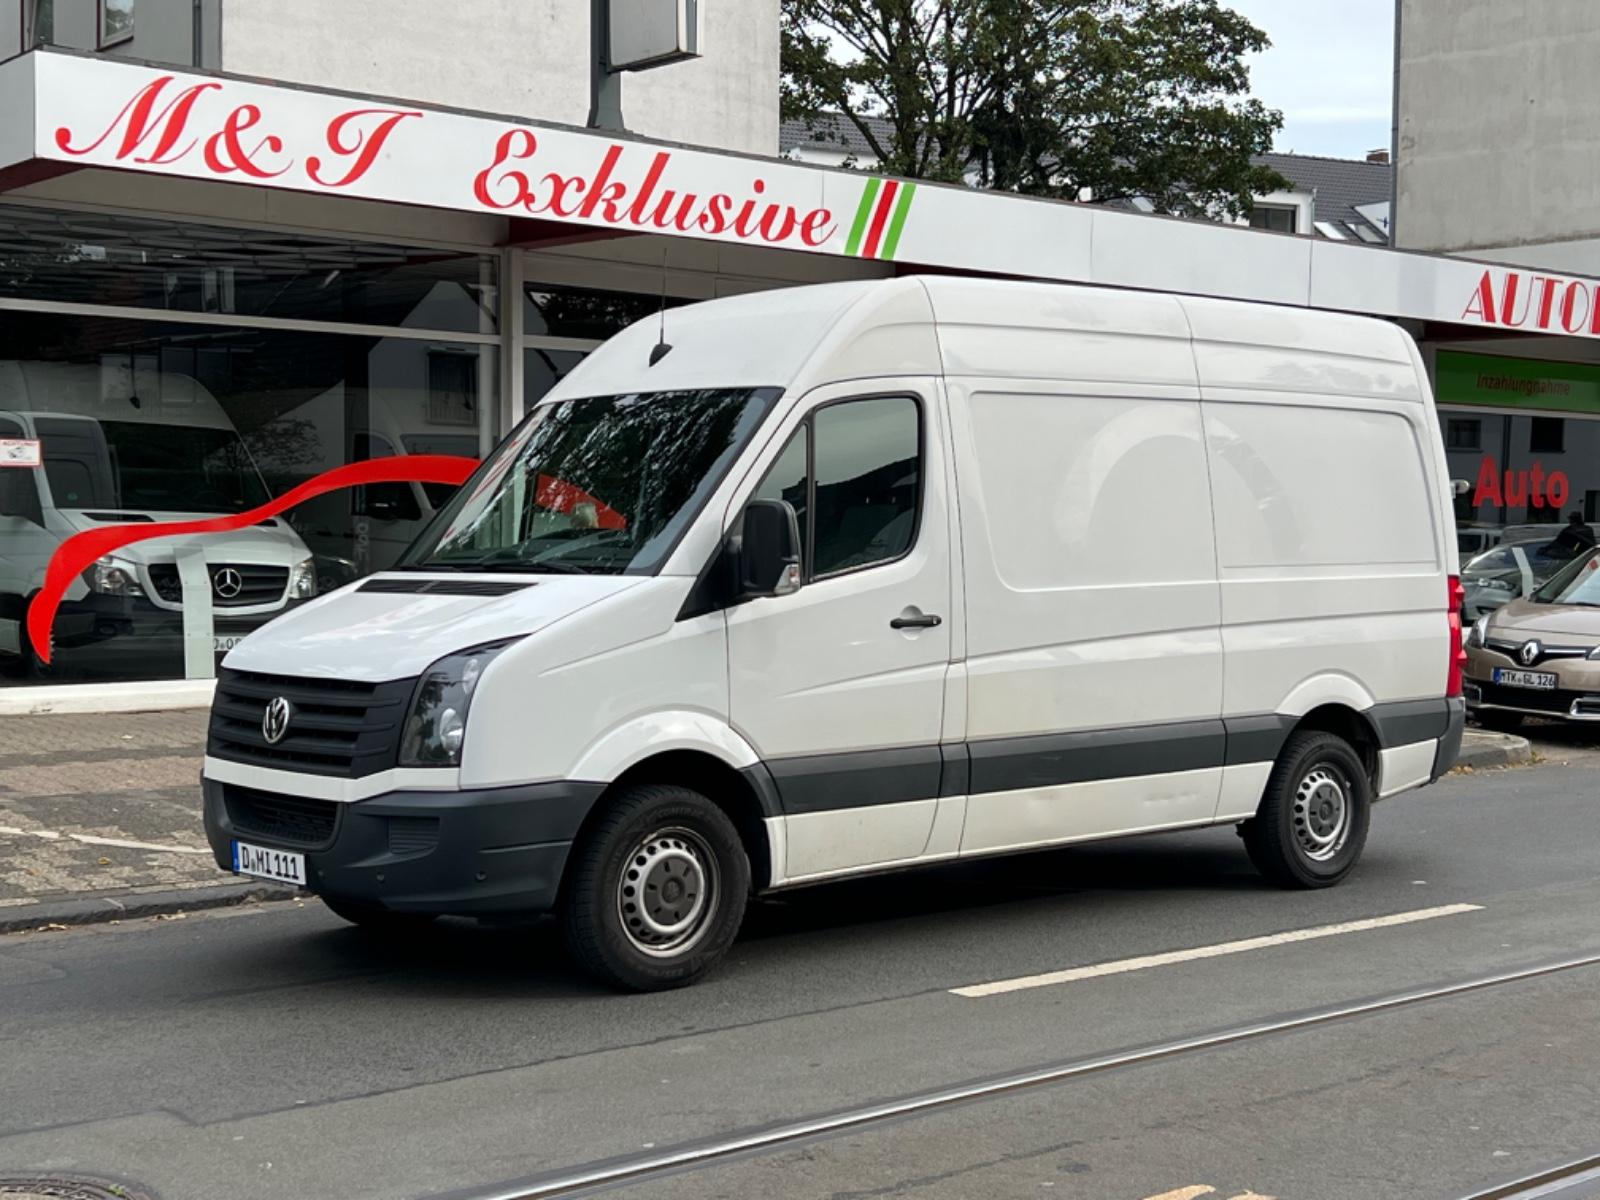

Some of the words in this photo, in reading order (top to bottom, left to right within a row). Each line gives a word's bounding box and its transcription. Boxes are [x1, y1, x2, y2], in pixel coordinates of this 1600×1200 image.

[473, 128, 838, 246] Exklusive
[1476, 371, 1571, 396] Inzahlungnahme
[1472, 454, 1569, 509] Auto
